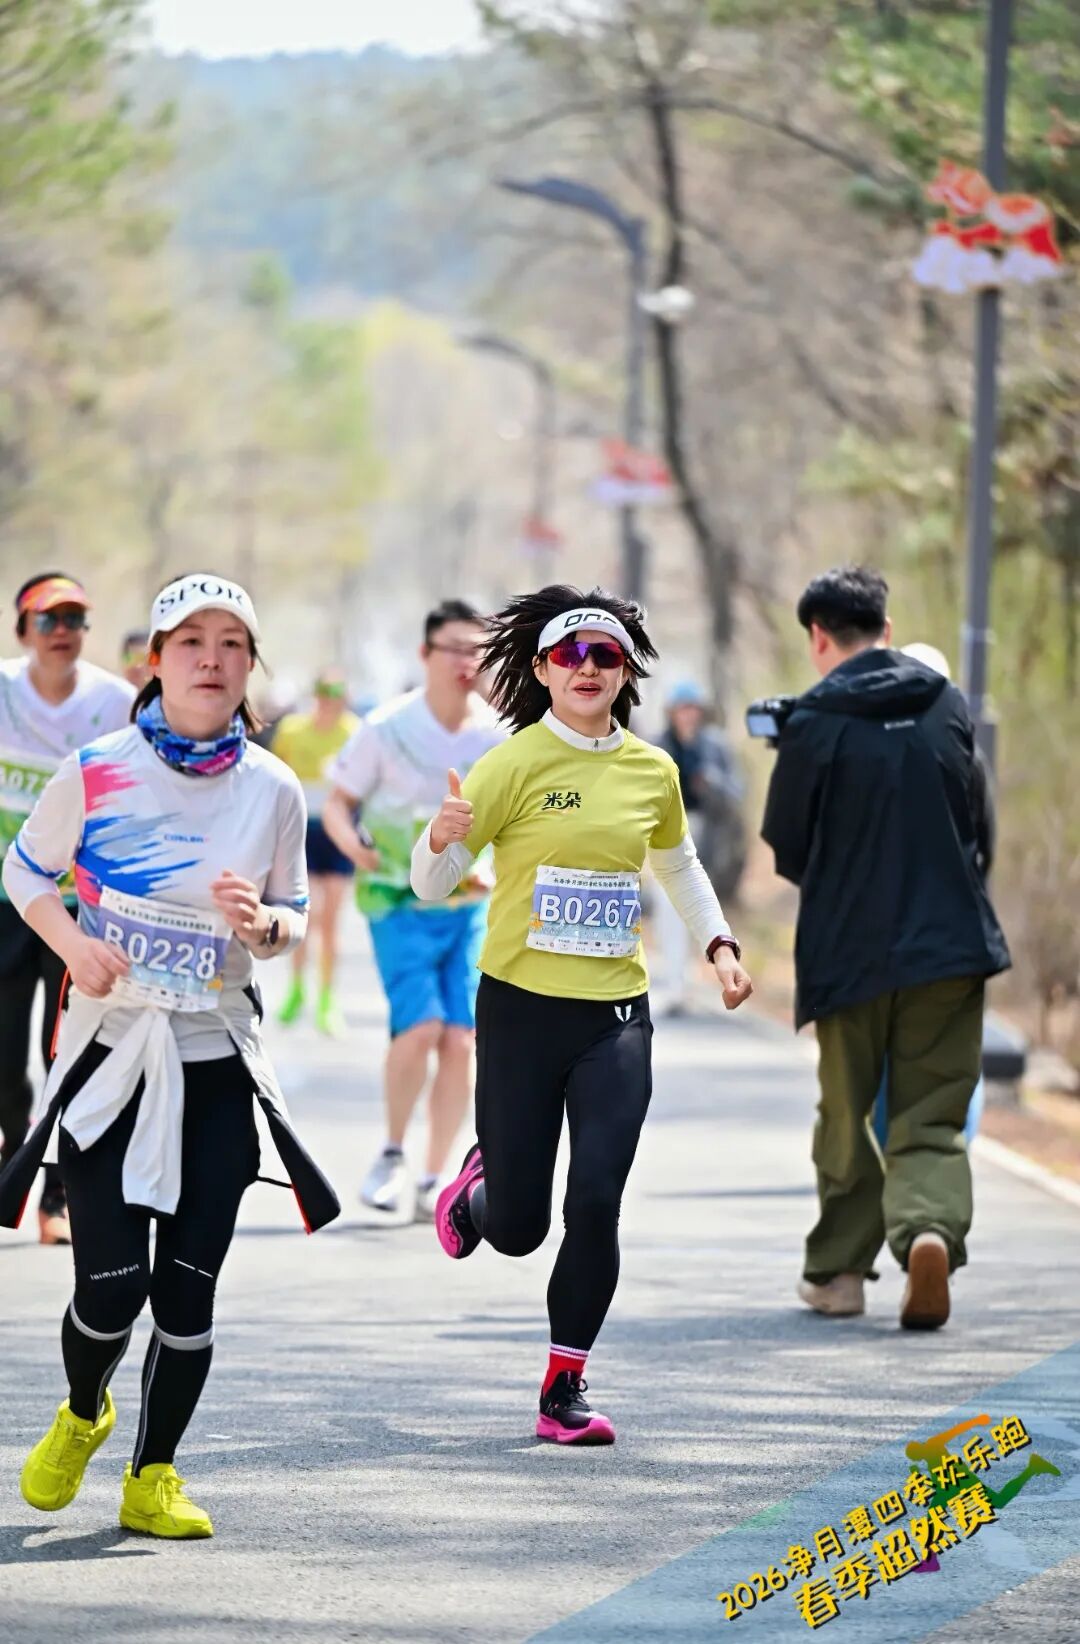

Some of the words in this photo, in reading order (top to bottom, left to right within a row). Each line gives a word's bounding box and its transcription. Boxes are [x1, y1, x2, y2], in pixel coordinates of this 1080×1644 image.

[541, 791, 582, 811] 米朵
[539, 893, 641, 929] B0267
[104, 920, 217, 980] B0228
